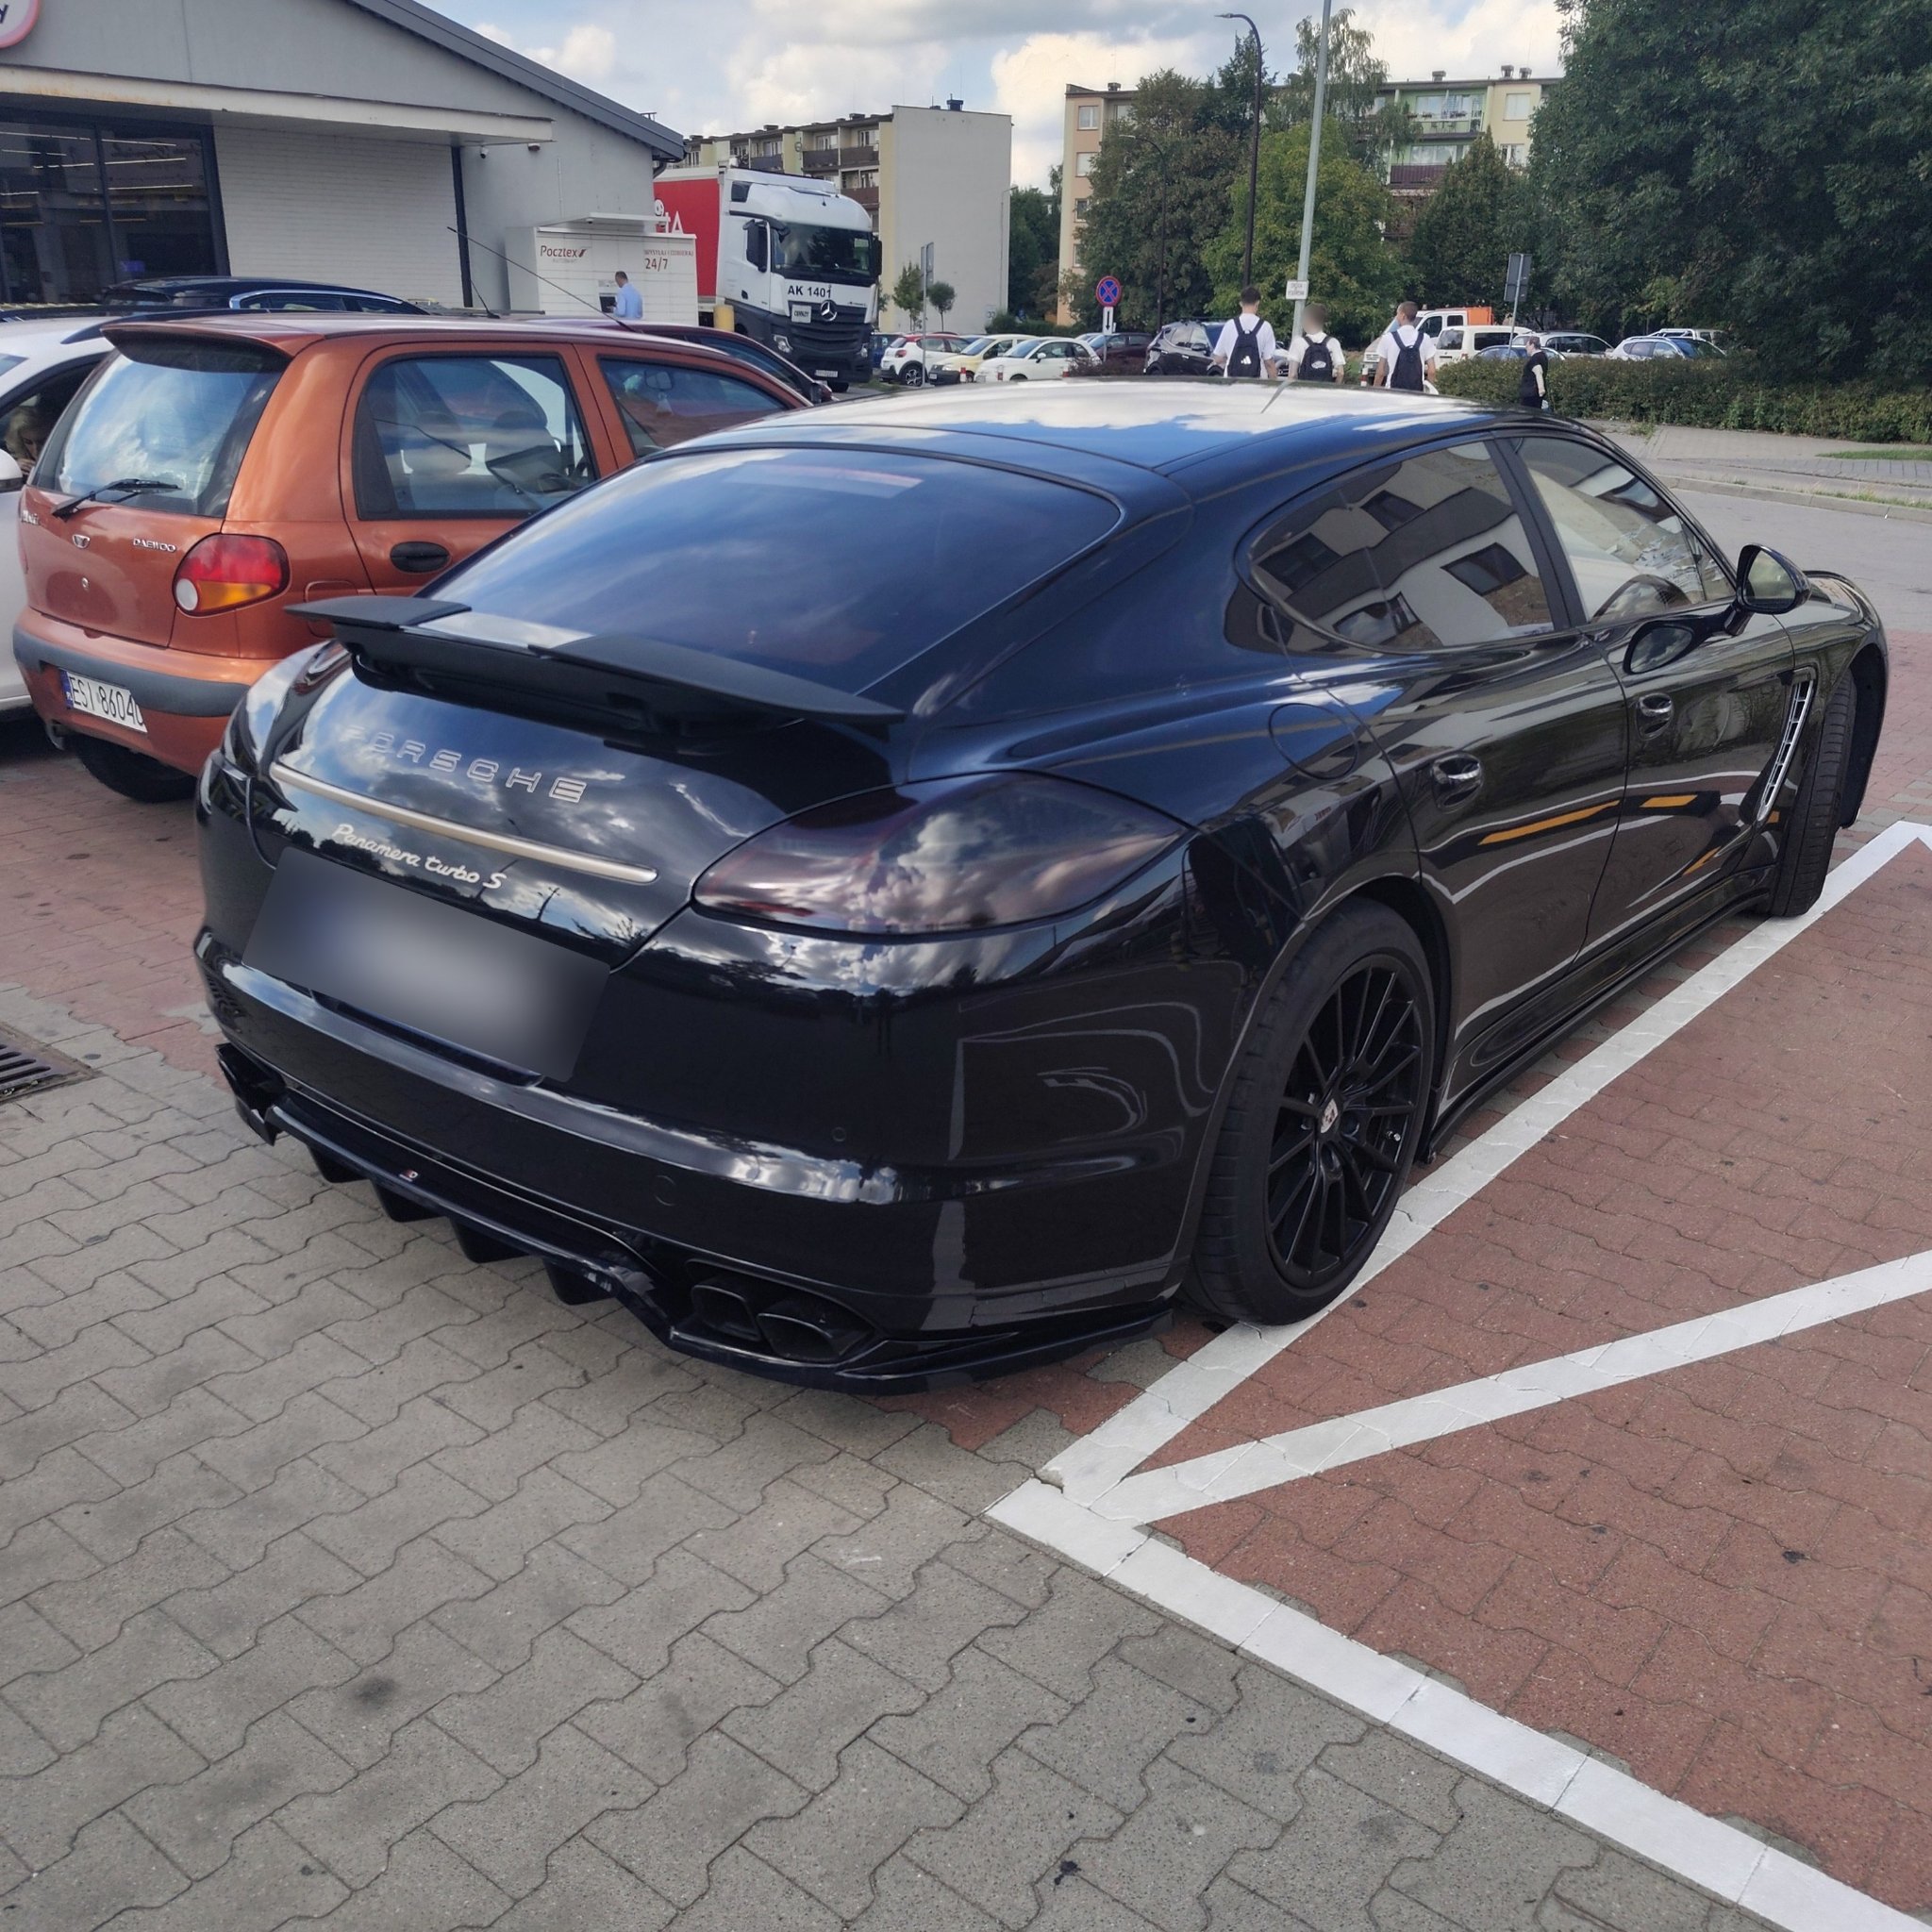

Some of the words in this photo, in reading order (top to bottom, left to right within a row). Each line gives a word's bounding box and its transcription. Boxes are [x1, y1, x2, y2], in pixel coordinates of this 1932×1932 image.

[540, 244, 578, 258] Pocztex
[644, 257, 668, 272] 24/7
[788, 285, 803, 296] AK
[808, 287, 831, 298] 1401
[133, 538, 176, 553] DAEWOO
[69, 676, 95, 711] ESI
[339, 724, 587, 803] PORSCHE
[331, 823, 422, 868] Panamera
[424, 855, 480, 884] turbo
[482, 871, 508, 890] S
